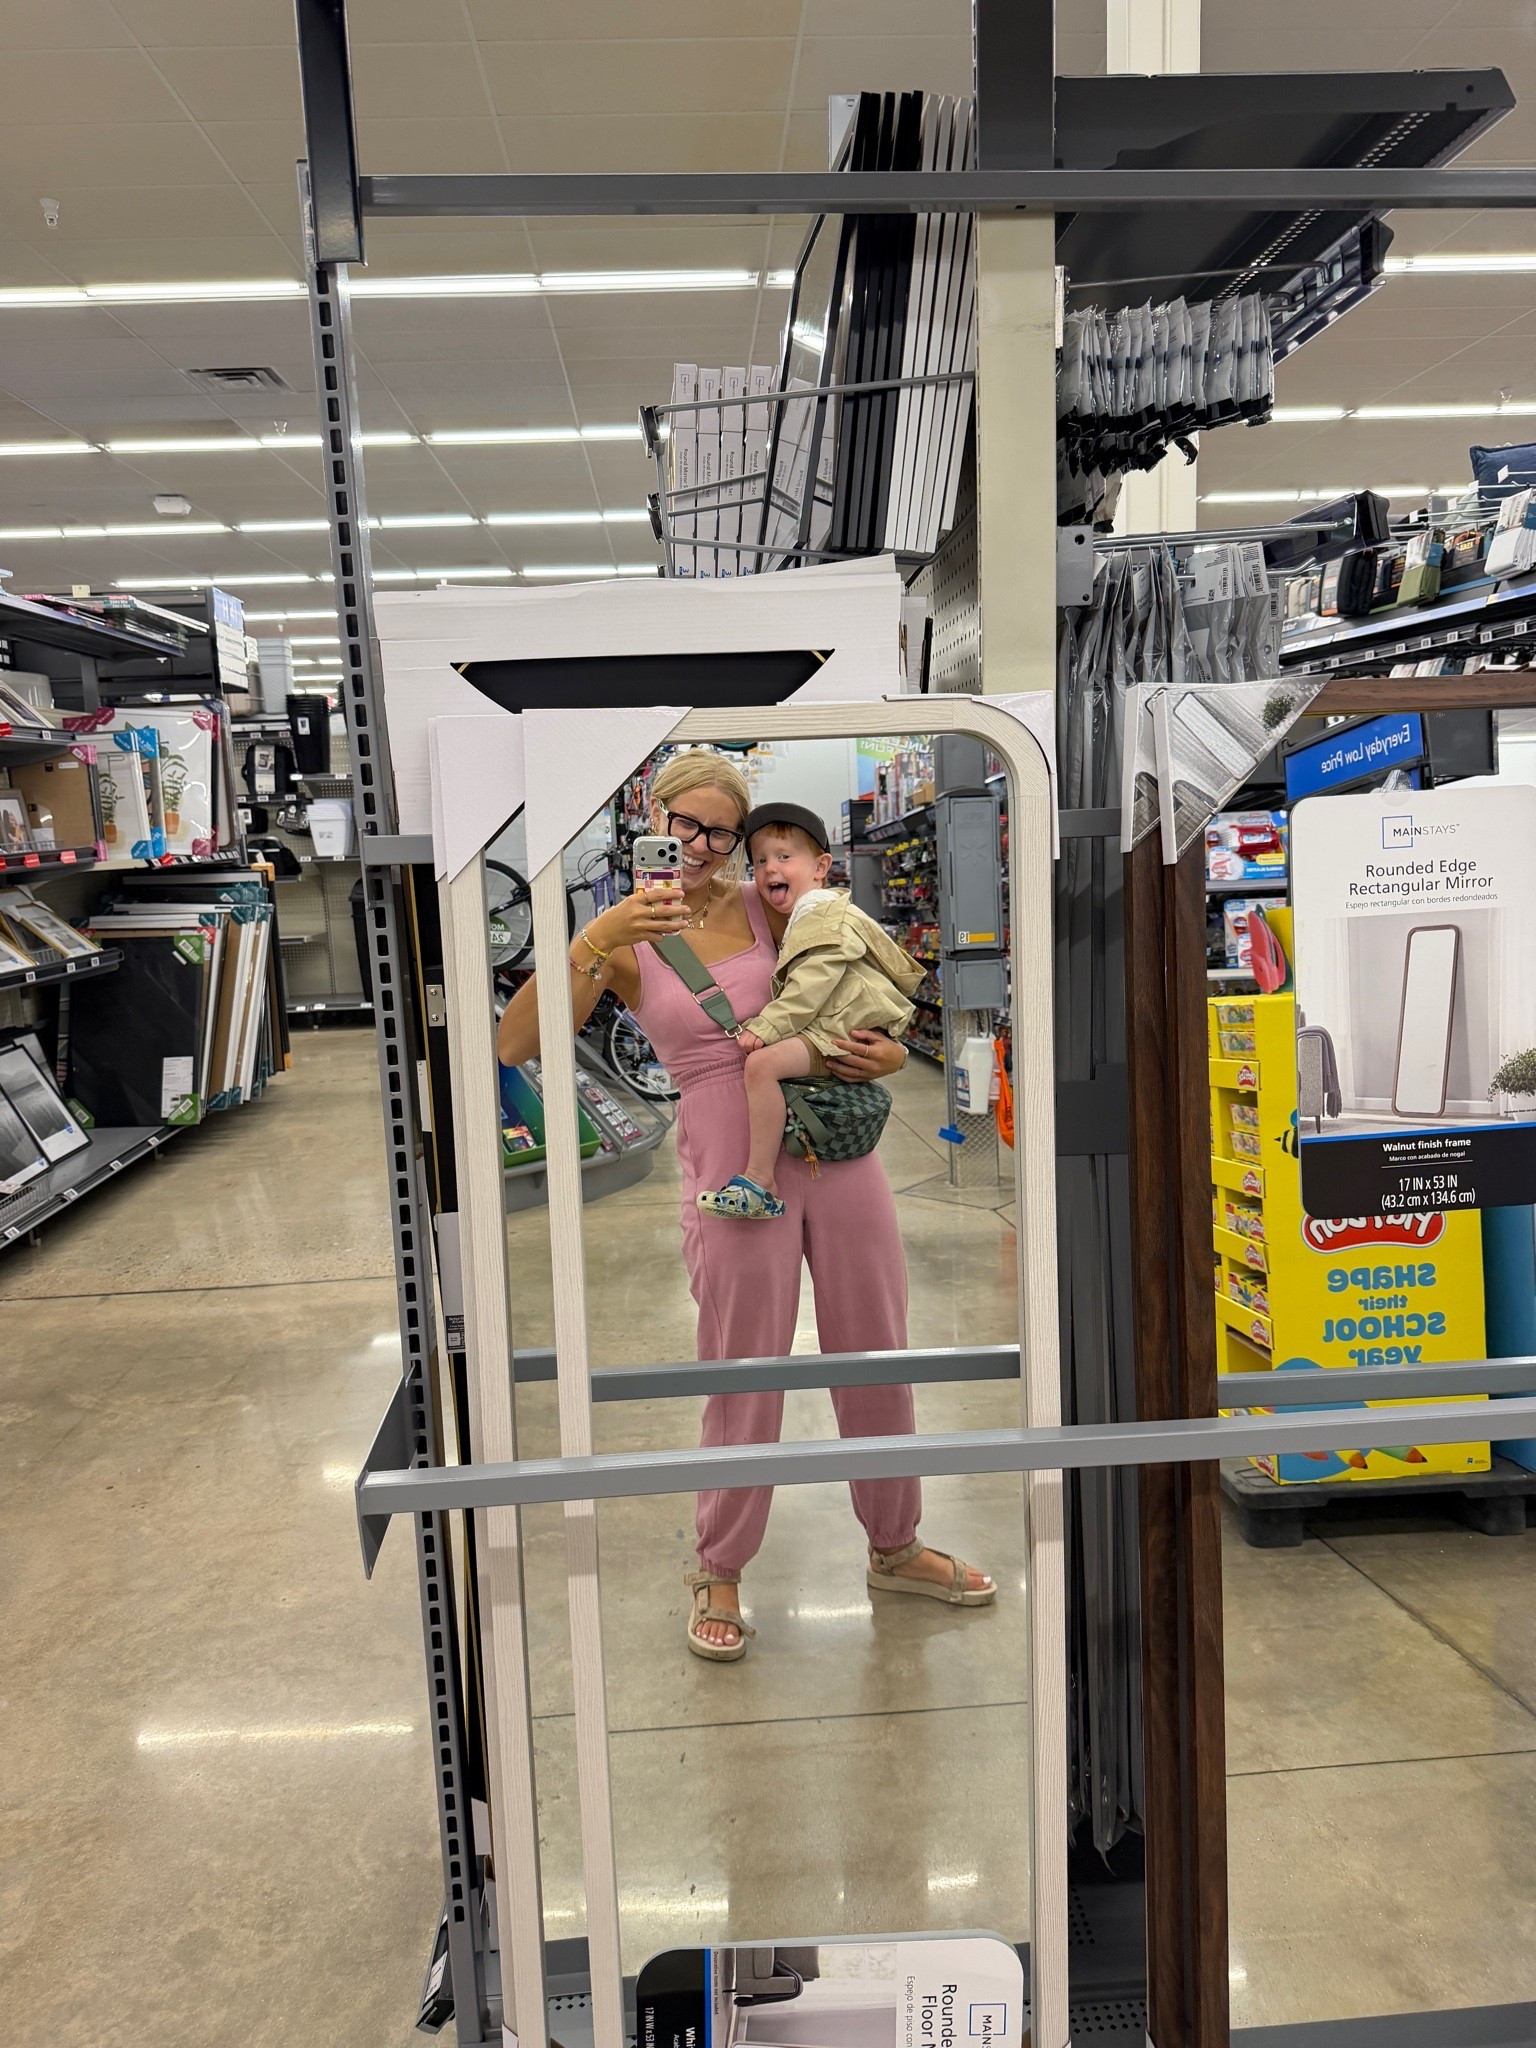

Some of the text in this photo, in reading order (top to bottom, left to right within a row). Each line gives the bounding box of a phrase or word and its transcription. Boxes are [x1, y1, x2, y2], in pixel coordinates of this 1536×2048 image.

[1366, 858, 1476, 878] Rounded Edge
[1350, 876, 1494, 896] Rectangular Mirror
[1370, 898, 1410, 907] rectangular
[1427, 895, 1450, 903] bordes
[1452, 892, 1498, 902] redondeados
[1382, 1138, 1471, 1152] Walnut finish frame
[1399, 1175, 1457, 1191] 17 IN x 53 IN
[1382, 1188, 1476, 1210] (43.2 cm x 134.6 cm)
[905, 1976, 915, 2001] Espejo
[906, 2004, 915, 2013] de
[921, 1996, 938, 2037] Floor
[941, 1985, 957, 2048] Rounde
[905, 2016, 914, 2031] piso
